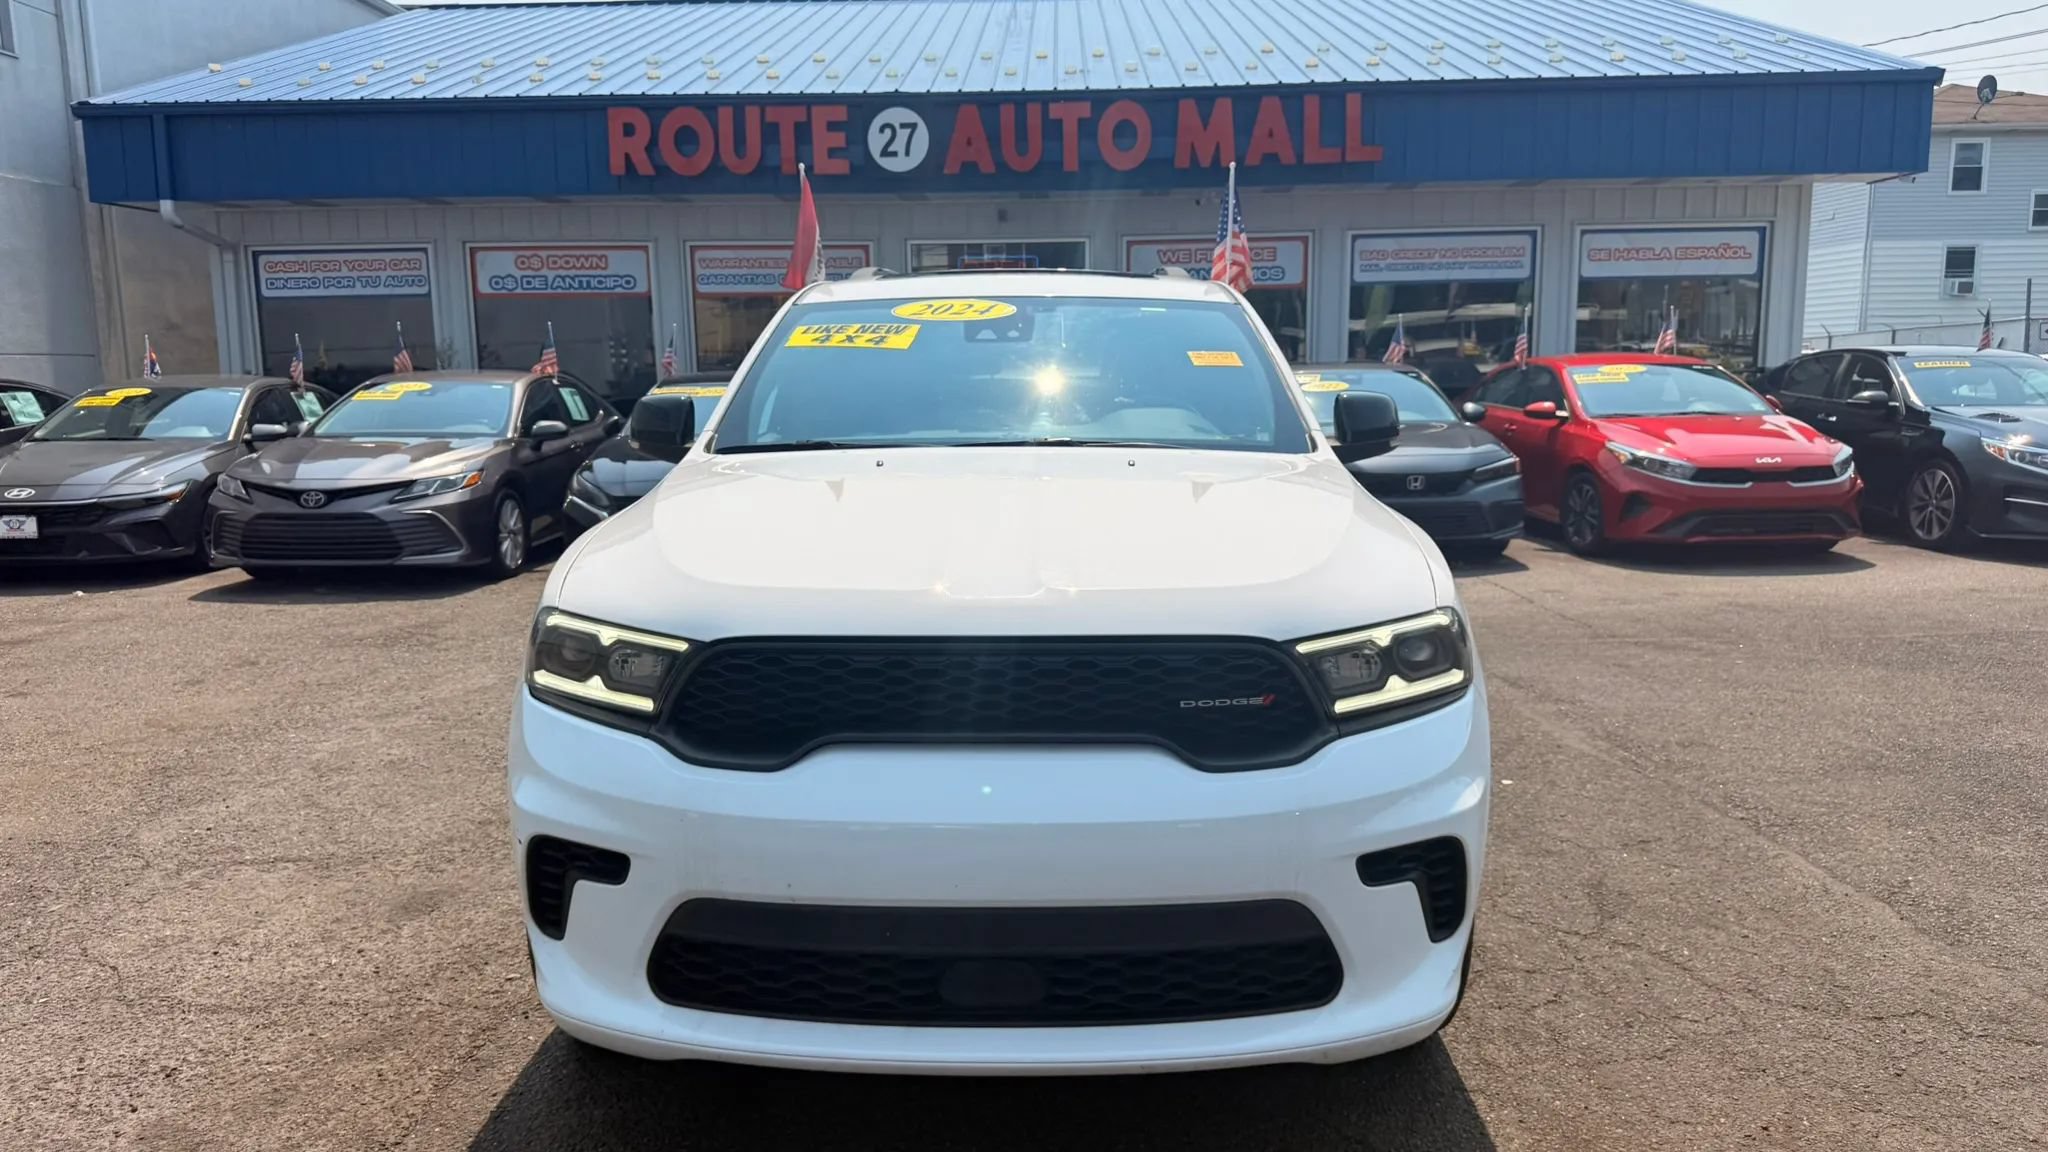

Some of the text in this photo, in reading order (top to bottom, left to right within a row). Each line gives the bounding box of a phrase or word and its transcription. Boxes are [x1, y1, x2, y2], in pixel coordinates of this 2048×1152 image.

[606, 92, 1384, 176] ROUTE 27 AUTO MALL
[1157, 249, 1194, 264] WE
[1360, 246, 1525, 261] BAD CREDIT NO PROBLEM
[1588, 243, 1752, 262] SE HABLA ESPAÑOL
[264, 258, 422, 273] CASH FOR YOUR CAR
[547, 254, 608, 270] DOWN
[266, 274, 427, 290] DINERO POR TU AUTO
[521, 274, 548, 290] DE
[550, 274, 637, 290] ANTICIPO
[697, 273, 777, 286] GARANTIAS
[909, 303, 1001, 317] 2024
[801, 323, 909, 336] LIKE NEW
[1179, 697, 1264, 708] DODGE
